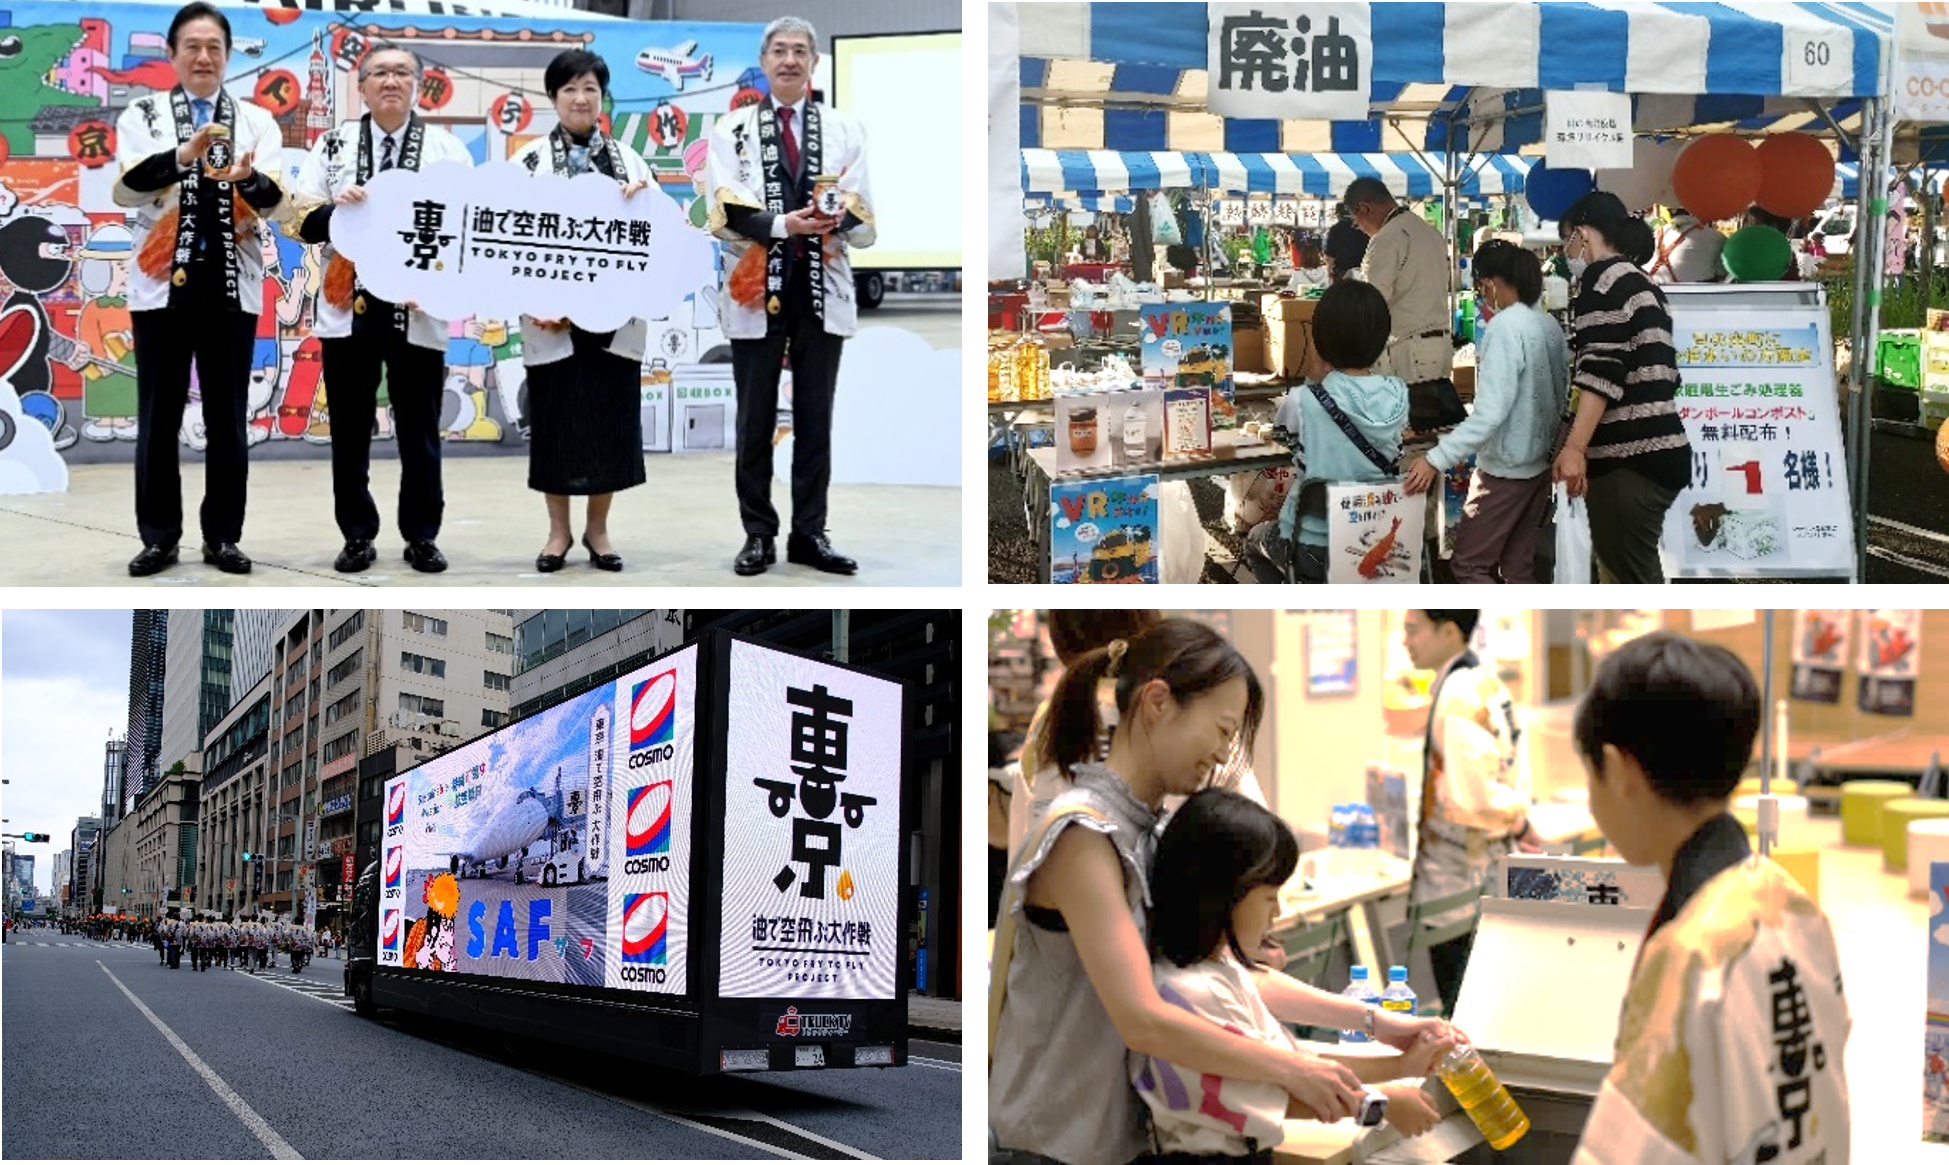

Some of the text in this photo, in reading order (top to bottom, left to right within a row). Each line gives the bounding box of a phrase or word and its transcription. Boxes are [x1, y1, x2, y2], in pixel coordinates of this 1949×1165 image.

[1218, 10, 1359, 92] 廃油
[1804, 41, 1831, 66] 60
[806, 104, 820, 151] TOKYO
[76, 125, 111, 159] 京
[403, 127, 423, 167] TOKYO
[472, 206, 652, 247] 油で空飛ぶ大作戦
[471, 247, 649, 272] TOKYO FRY TO FLY
[511, 266, 598, 283] PROJECT
[1147, 310, 1190, 338] VR
[1060, 490, 1109, 523] VR
[629, 745, 674, 770] COSMO
[624, 857, 670, 875] COSMO
[467, 899, 552, 961] SAF
[752, 914, 872, 946] 油で空飛ぶ大作戦
[621, 967, 666, 984] COSMO
[759, 957, 865, 970] TOKYO FRY TO FLY
[787, 972, 838, 983] PROJECT
